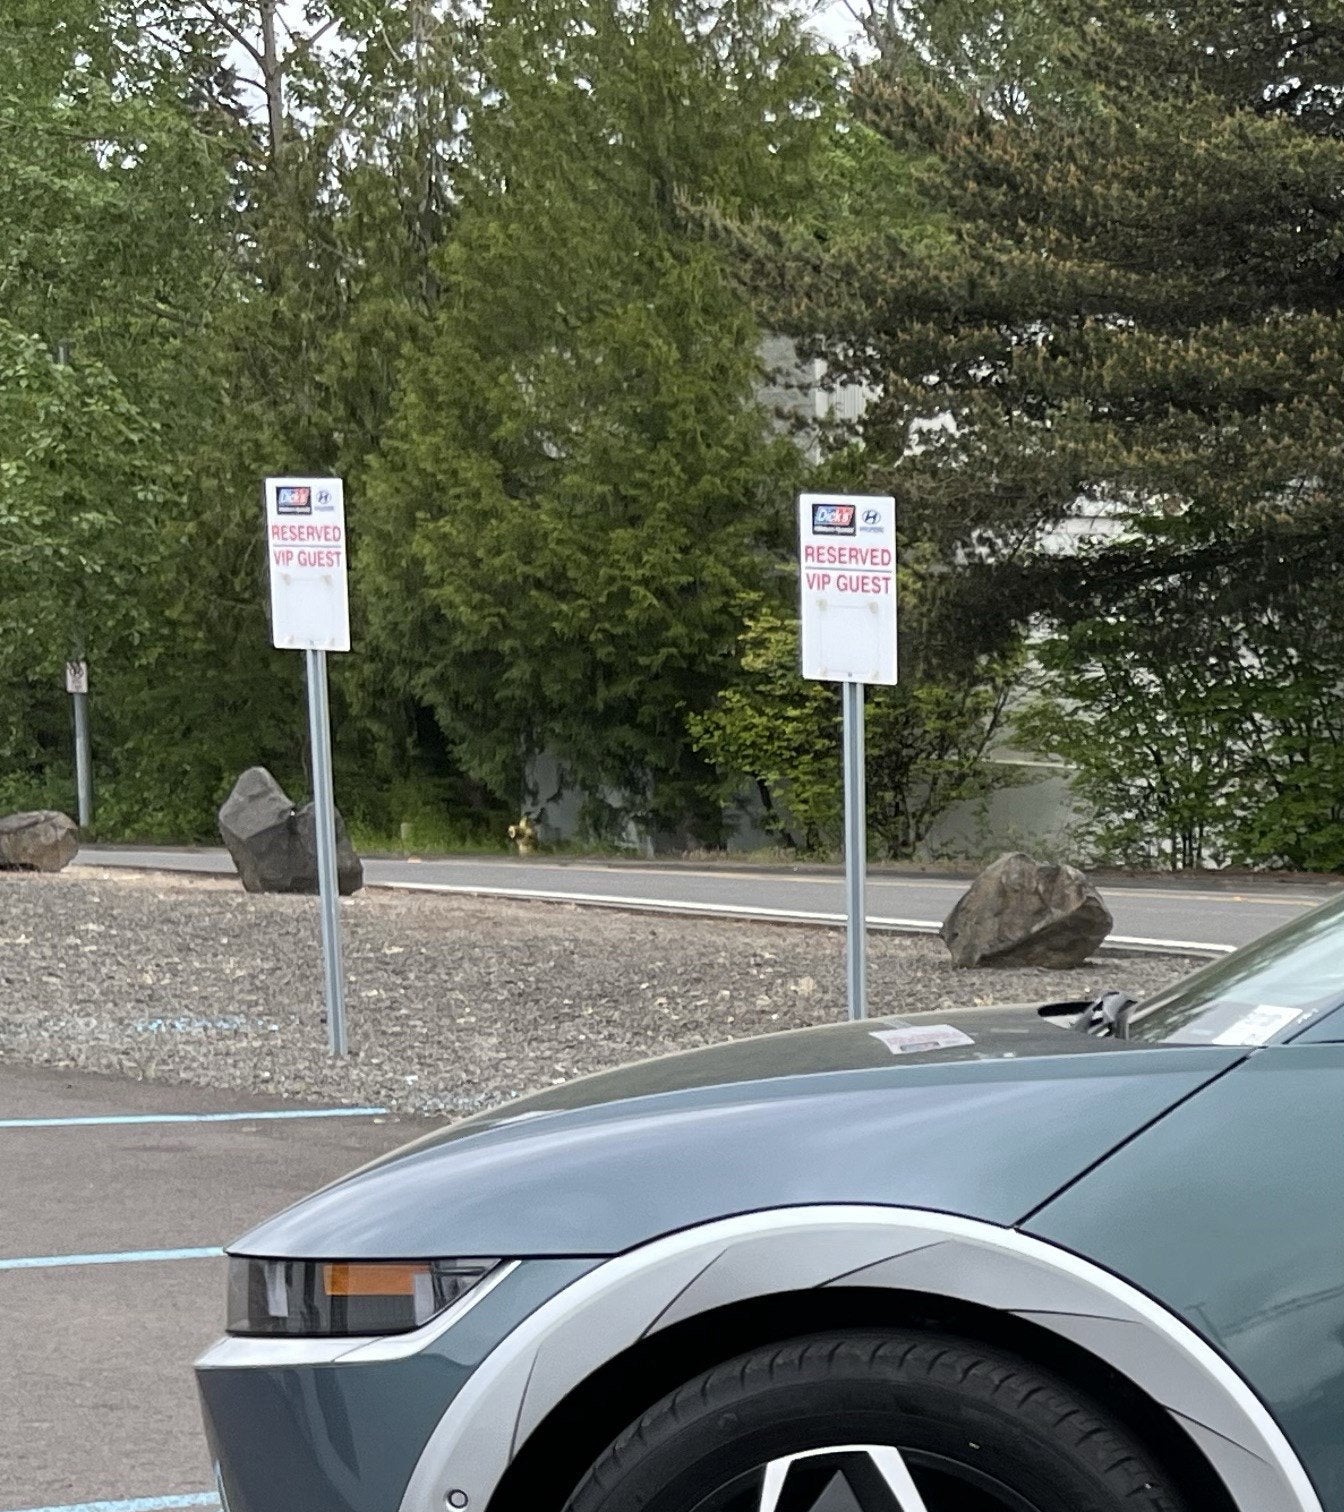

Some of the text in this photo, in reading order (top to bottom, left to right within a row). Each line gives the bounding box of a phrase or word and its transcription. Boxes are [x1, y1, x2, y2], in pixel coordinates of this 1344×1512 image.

[271, 525, 342, 542] RESERVED
[273, 550, 341, 568] VIP GUEST
[804, 545, 893, 566] RESERVED
[805, 572, 892, 595] VIP GUEST
